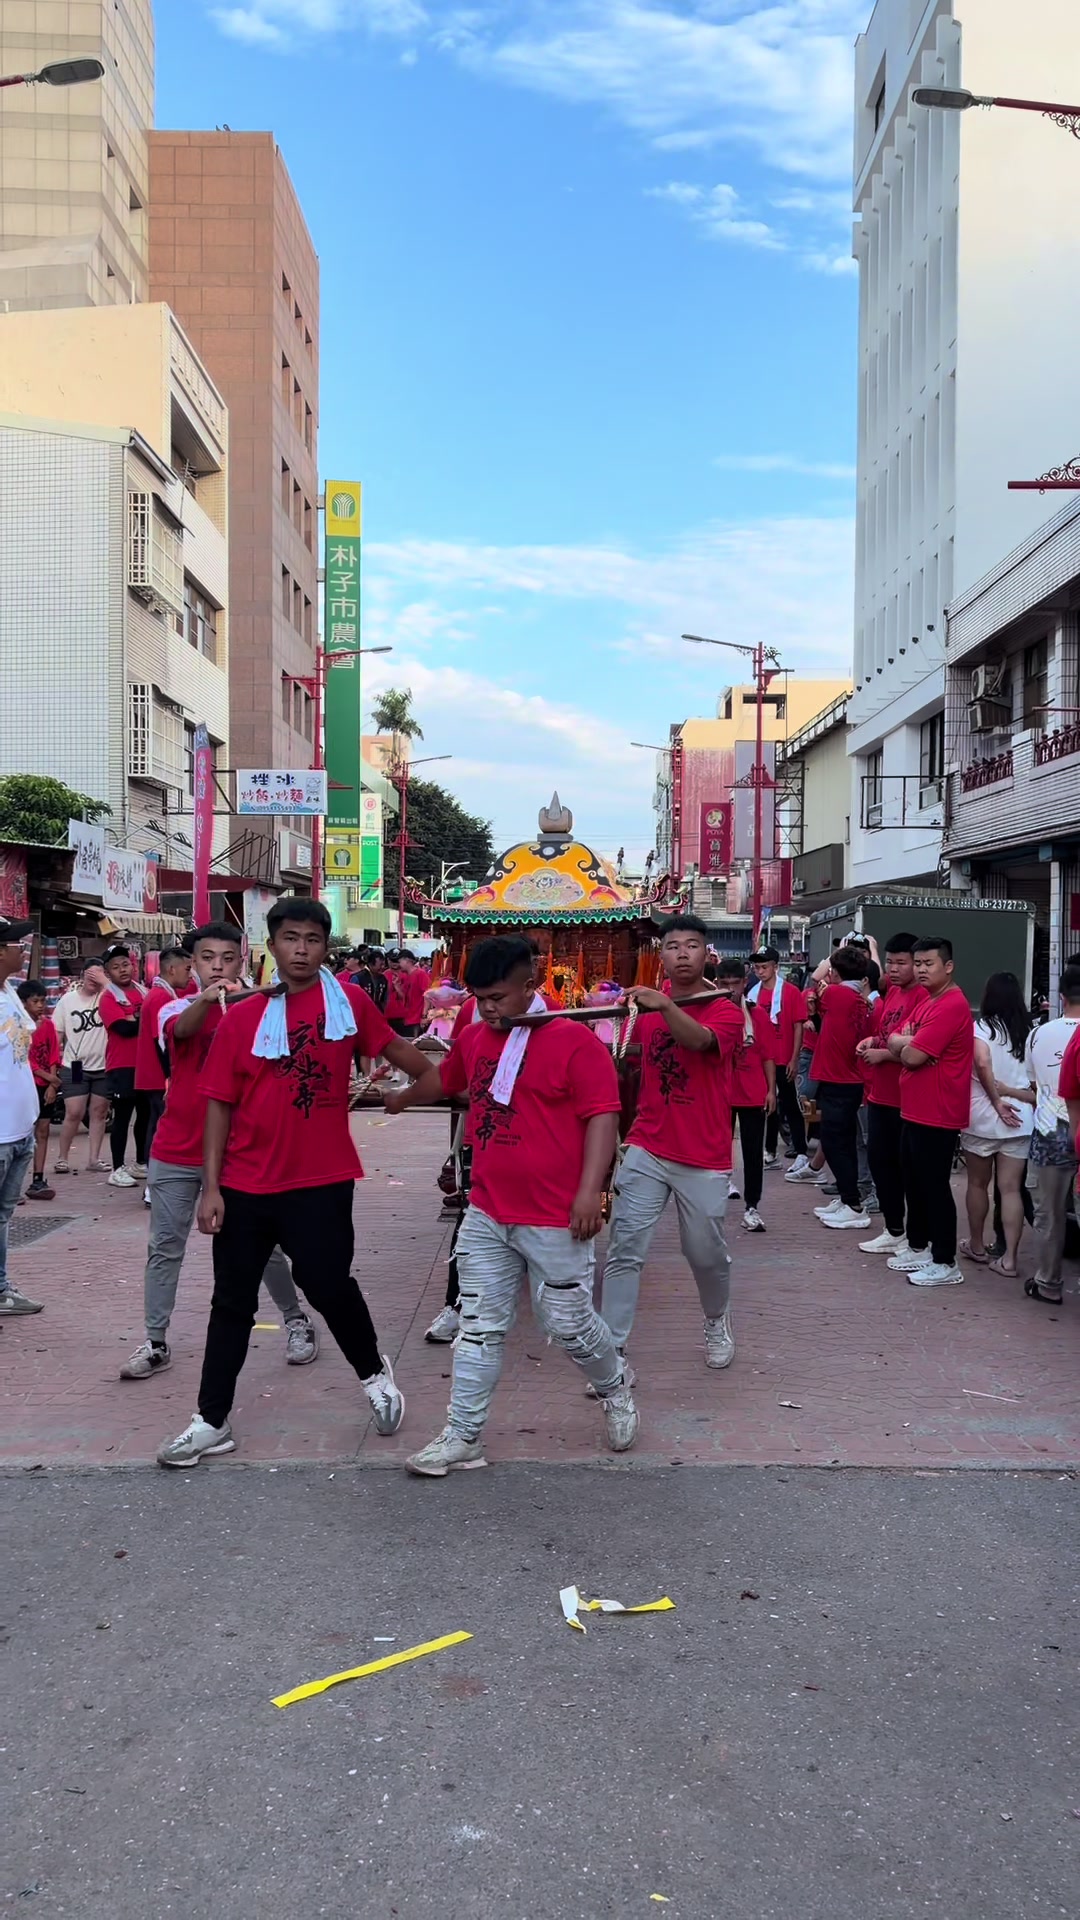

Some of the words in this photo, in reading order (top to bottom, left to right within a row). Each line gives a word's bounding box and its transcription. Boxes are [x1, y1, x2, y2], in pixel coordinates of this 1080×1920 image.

[329, 543, 358, 669] 朴子市農會
